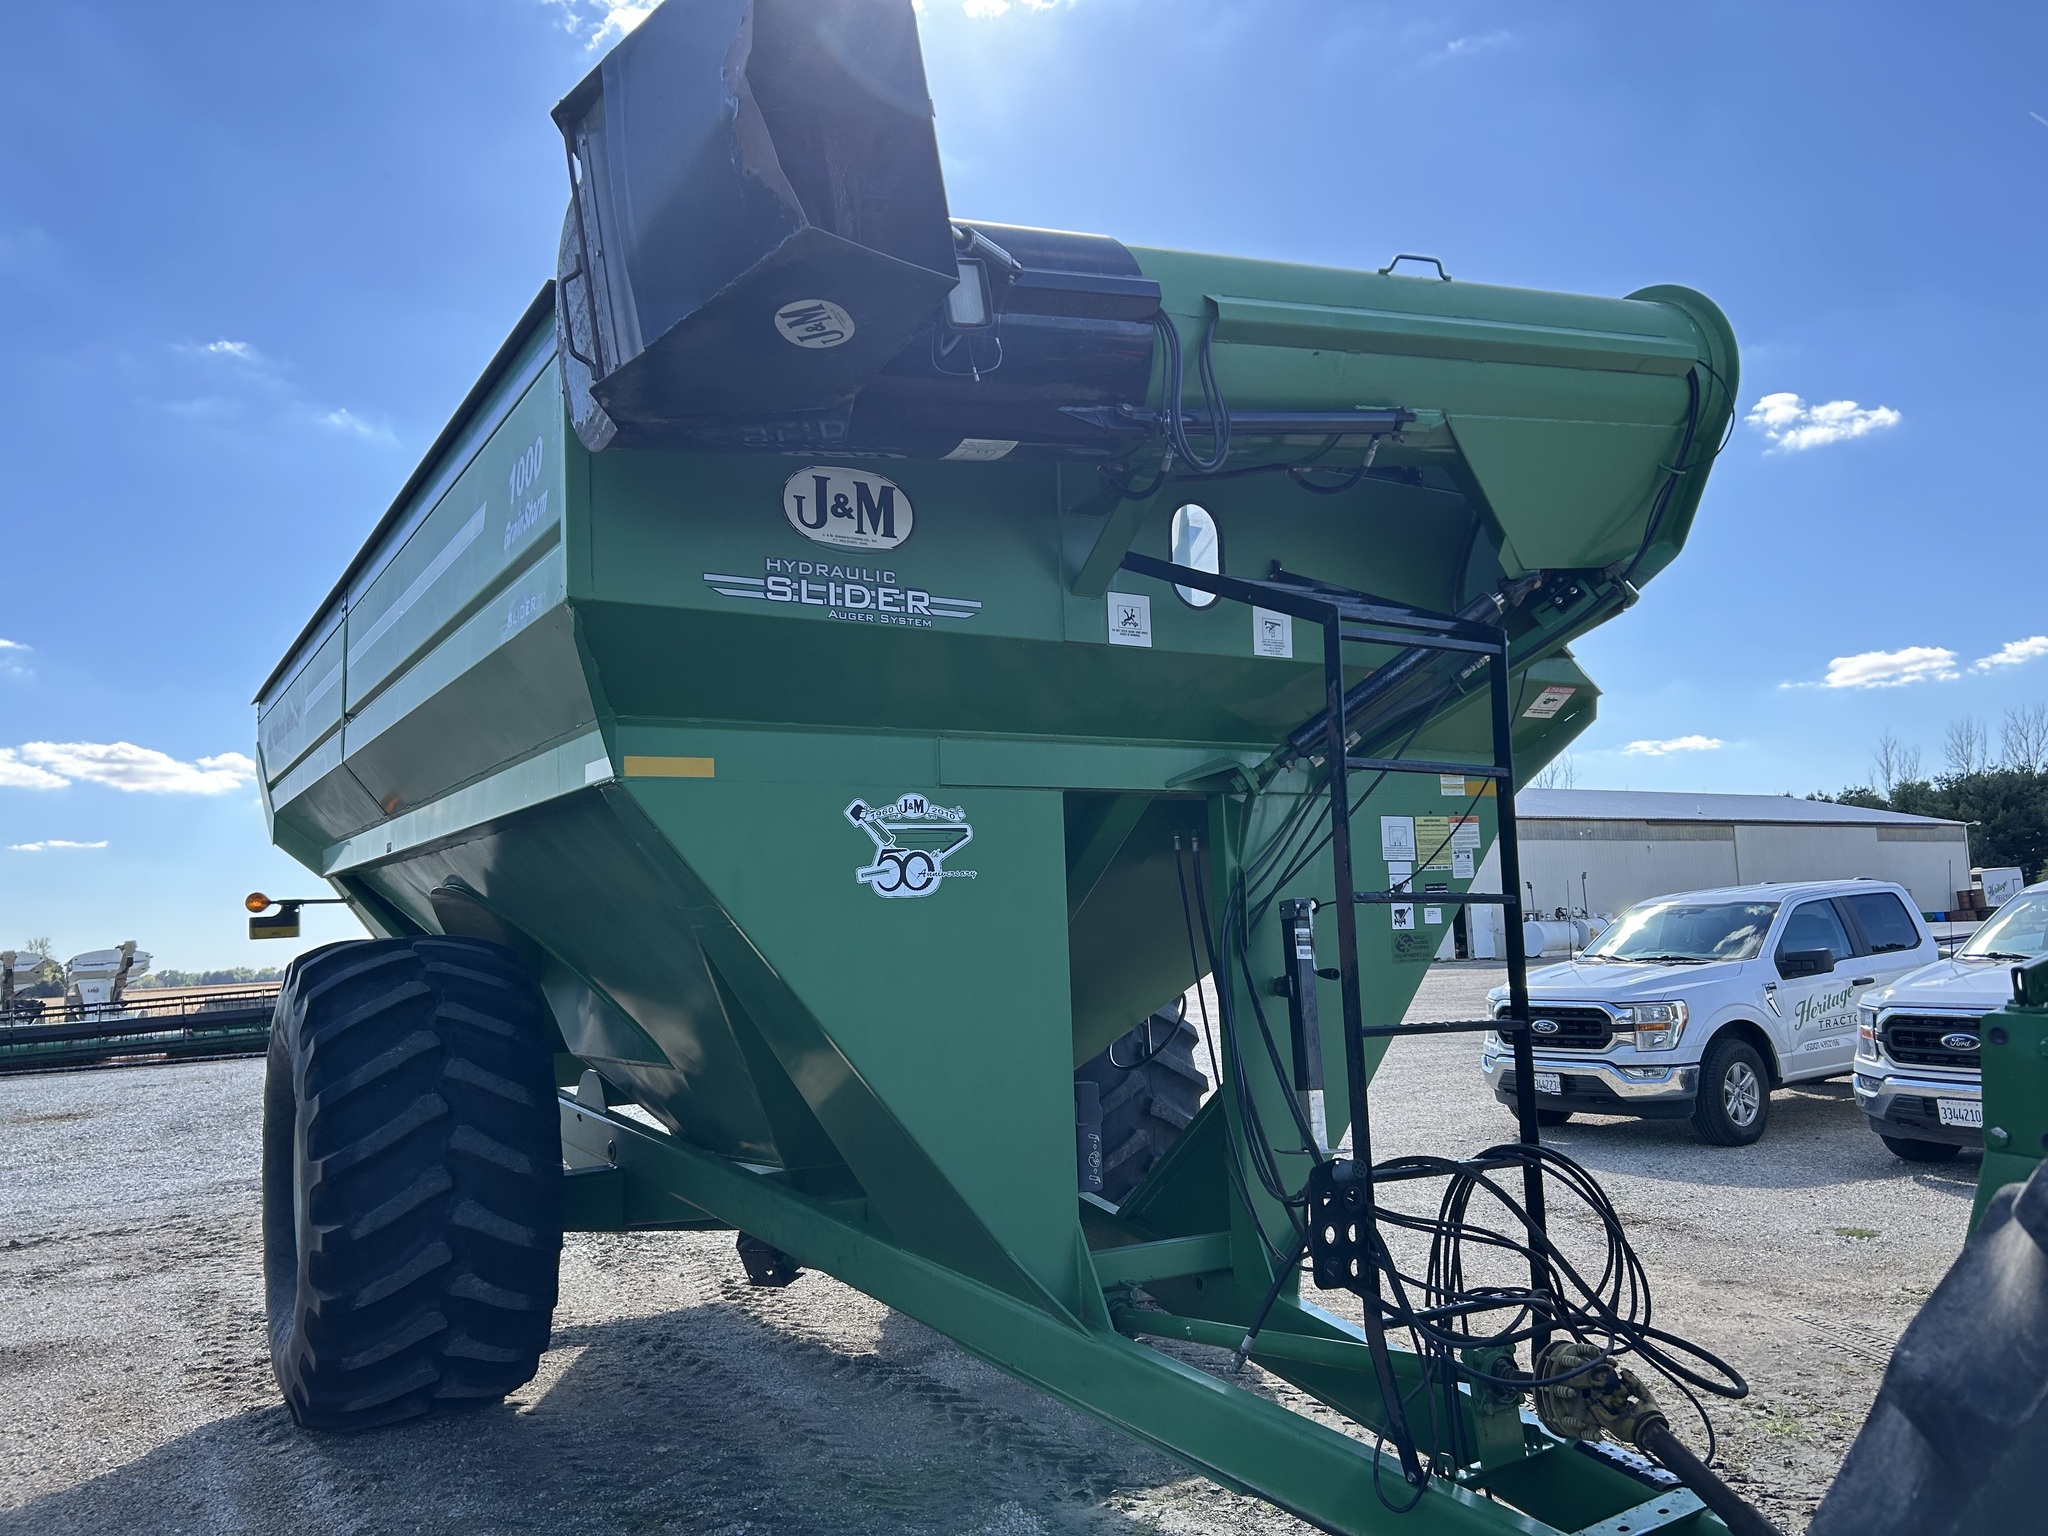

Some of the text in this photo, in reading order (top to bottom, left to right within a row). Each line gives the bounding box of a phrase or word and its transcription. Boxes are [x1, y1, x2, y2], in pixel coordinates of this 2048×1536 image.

[509, 435, 543, 505] 1000
[793, 475, 898, 539] J&M
[766, 558, 896, 584] HYDRAULIC
[766, 576, 933, 616] SLIDER
[507, 596, 537, 629] SLIDER
[871, 799, 956, 820] 1960 J&M 2010
[917, 868, 977, 879] Anniversary
[1794, 985, 1854, 1031] Heritage
[1804, 1041, 1821, 1052] USDOT
[1949, 1036, 1971, 1047] Ford
[1941, 1107, 1982, 1122] 3344210
